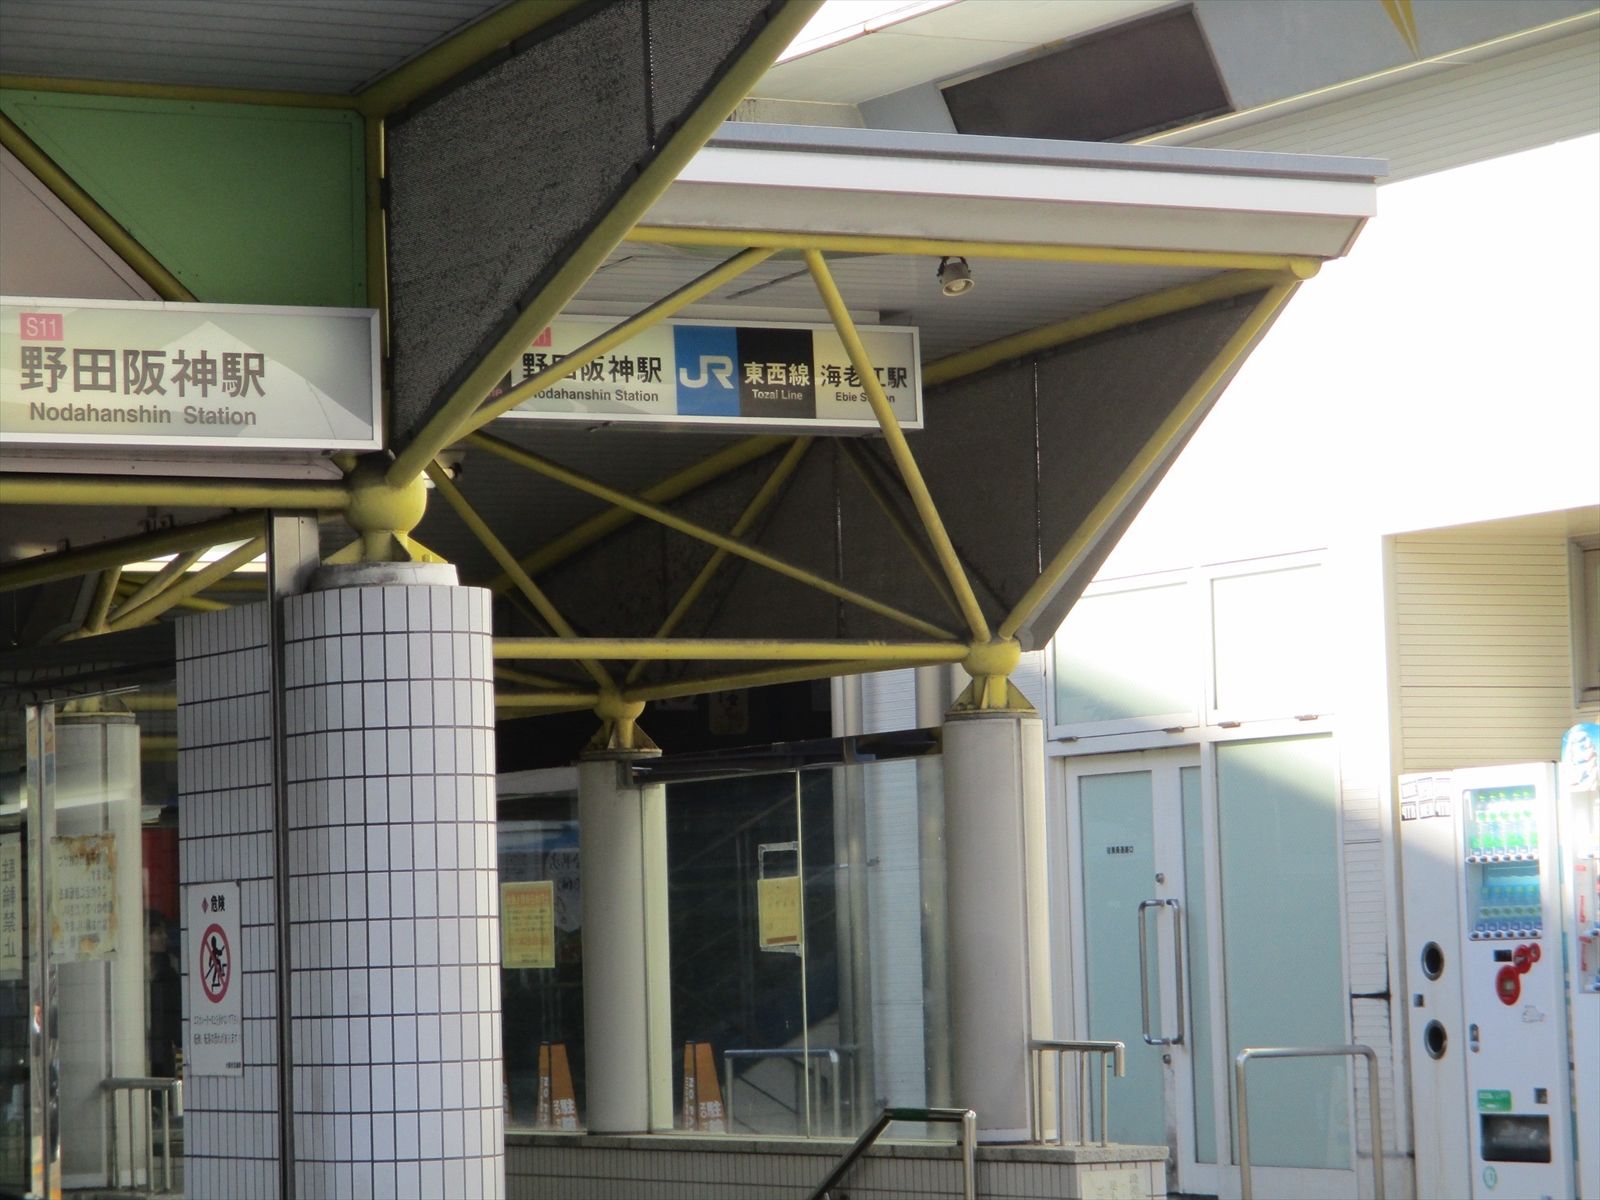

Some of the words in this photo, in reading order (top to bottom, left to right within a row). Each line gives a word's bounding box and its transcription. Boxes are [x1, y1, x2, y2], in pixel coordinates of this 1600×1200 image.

[26, 317, 58, 337] S11
[20, 345, 266, 398] 野田阪神駅
[679, 355, 734, 389] JR
[744, 362, 810, 386] 東西線
[533, 388, 611, 401] odahanshin
[615, 390, 659, 402] Station
[781, 390, 803, 400] Line
[835, 392, 857, 401] Ebie
[30, 402, 171, 424] Nodahanshin
[183, 405, 257, 426] Station
[210, 895, 226, 913] 危険
